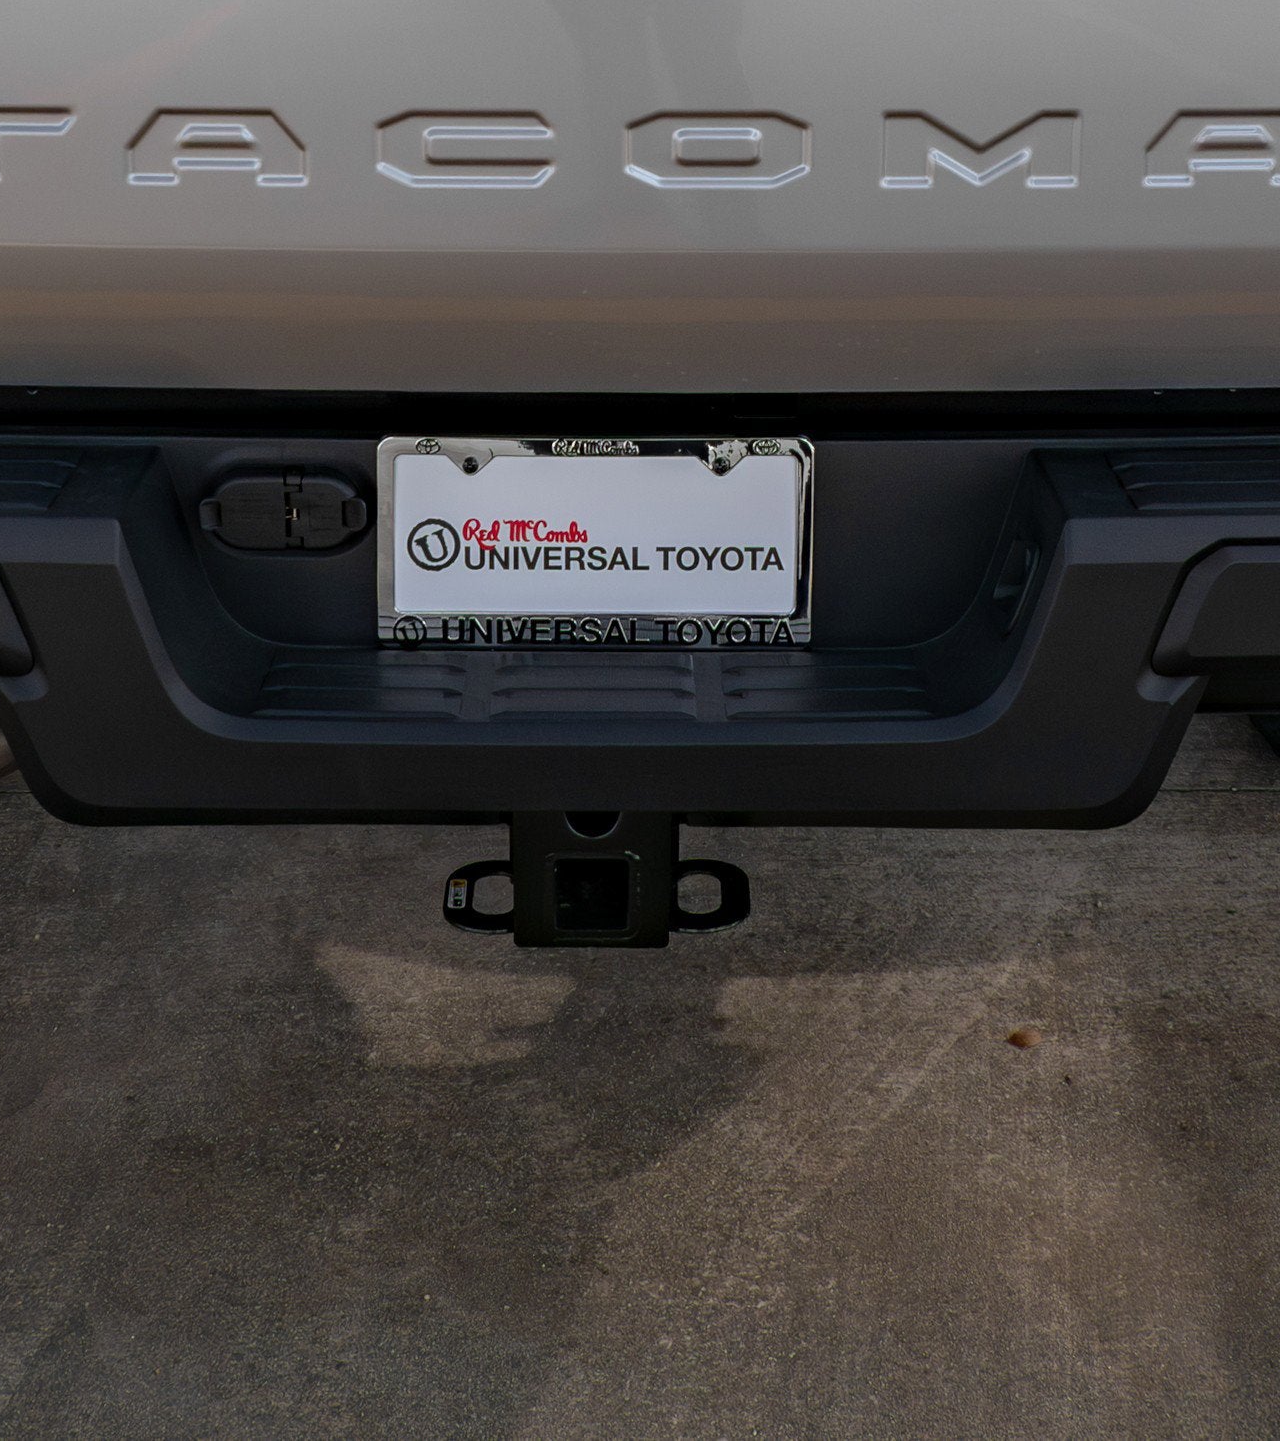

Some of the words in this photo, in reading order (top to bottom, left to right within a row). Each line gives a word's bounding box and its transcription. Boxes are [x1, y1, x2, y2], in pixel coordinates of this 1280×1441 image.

[463, 518, 500, 550] Red
[503, 520, 588, 543] McCombs
[464, 545, 650, 571] UNIVERSAL
[656, 546, 784, 571] TOYOTA
[441, 617, 650, 644] UNIVERSAL
[653, 618, 796, 645] TOYOTA
